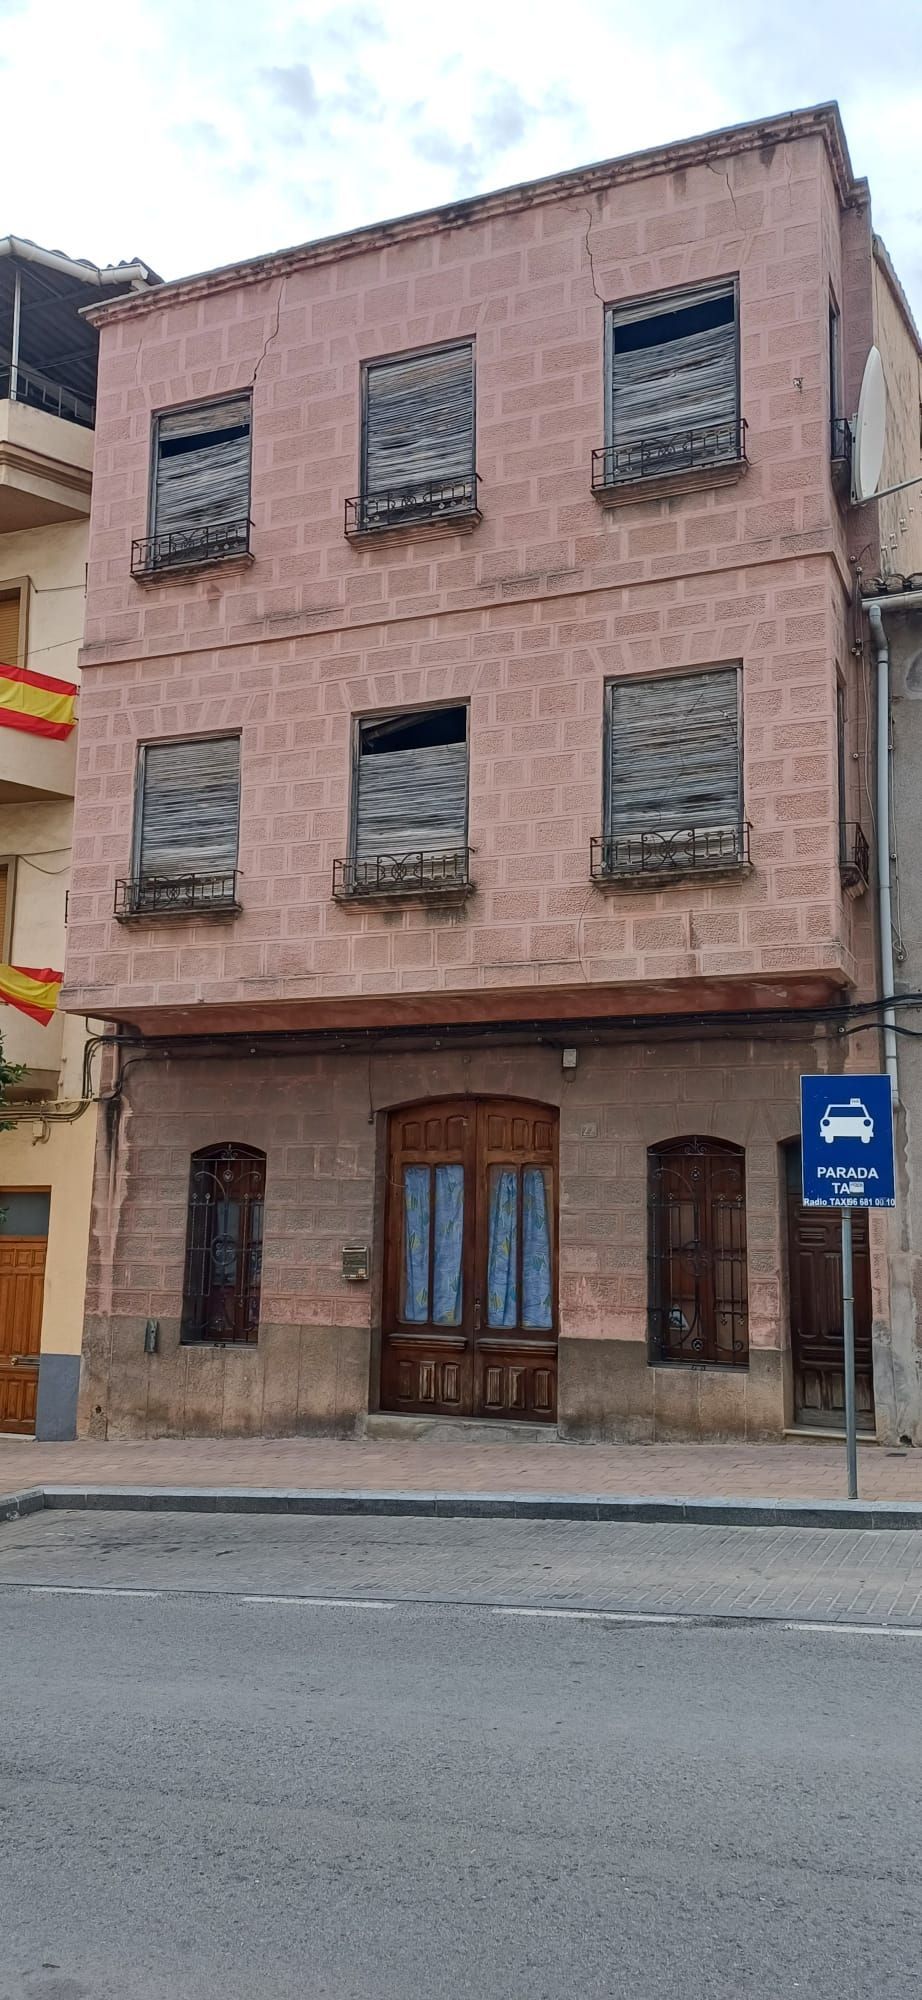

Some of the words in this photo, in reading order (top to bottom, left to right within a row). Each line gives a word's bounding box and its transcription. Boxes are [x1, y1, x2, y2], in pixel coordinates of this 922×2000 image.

[817, 1166, 879, 1179] PARADA
[804, 1198, 828, 1206] Radio
[860, 1198, 873, 1206] 681
[875, 1198, 885, 1206] 00
[886, 1198, 896, 1206] 10
